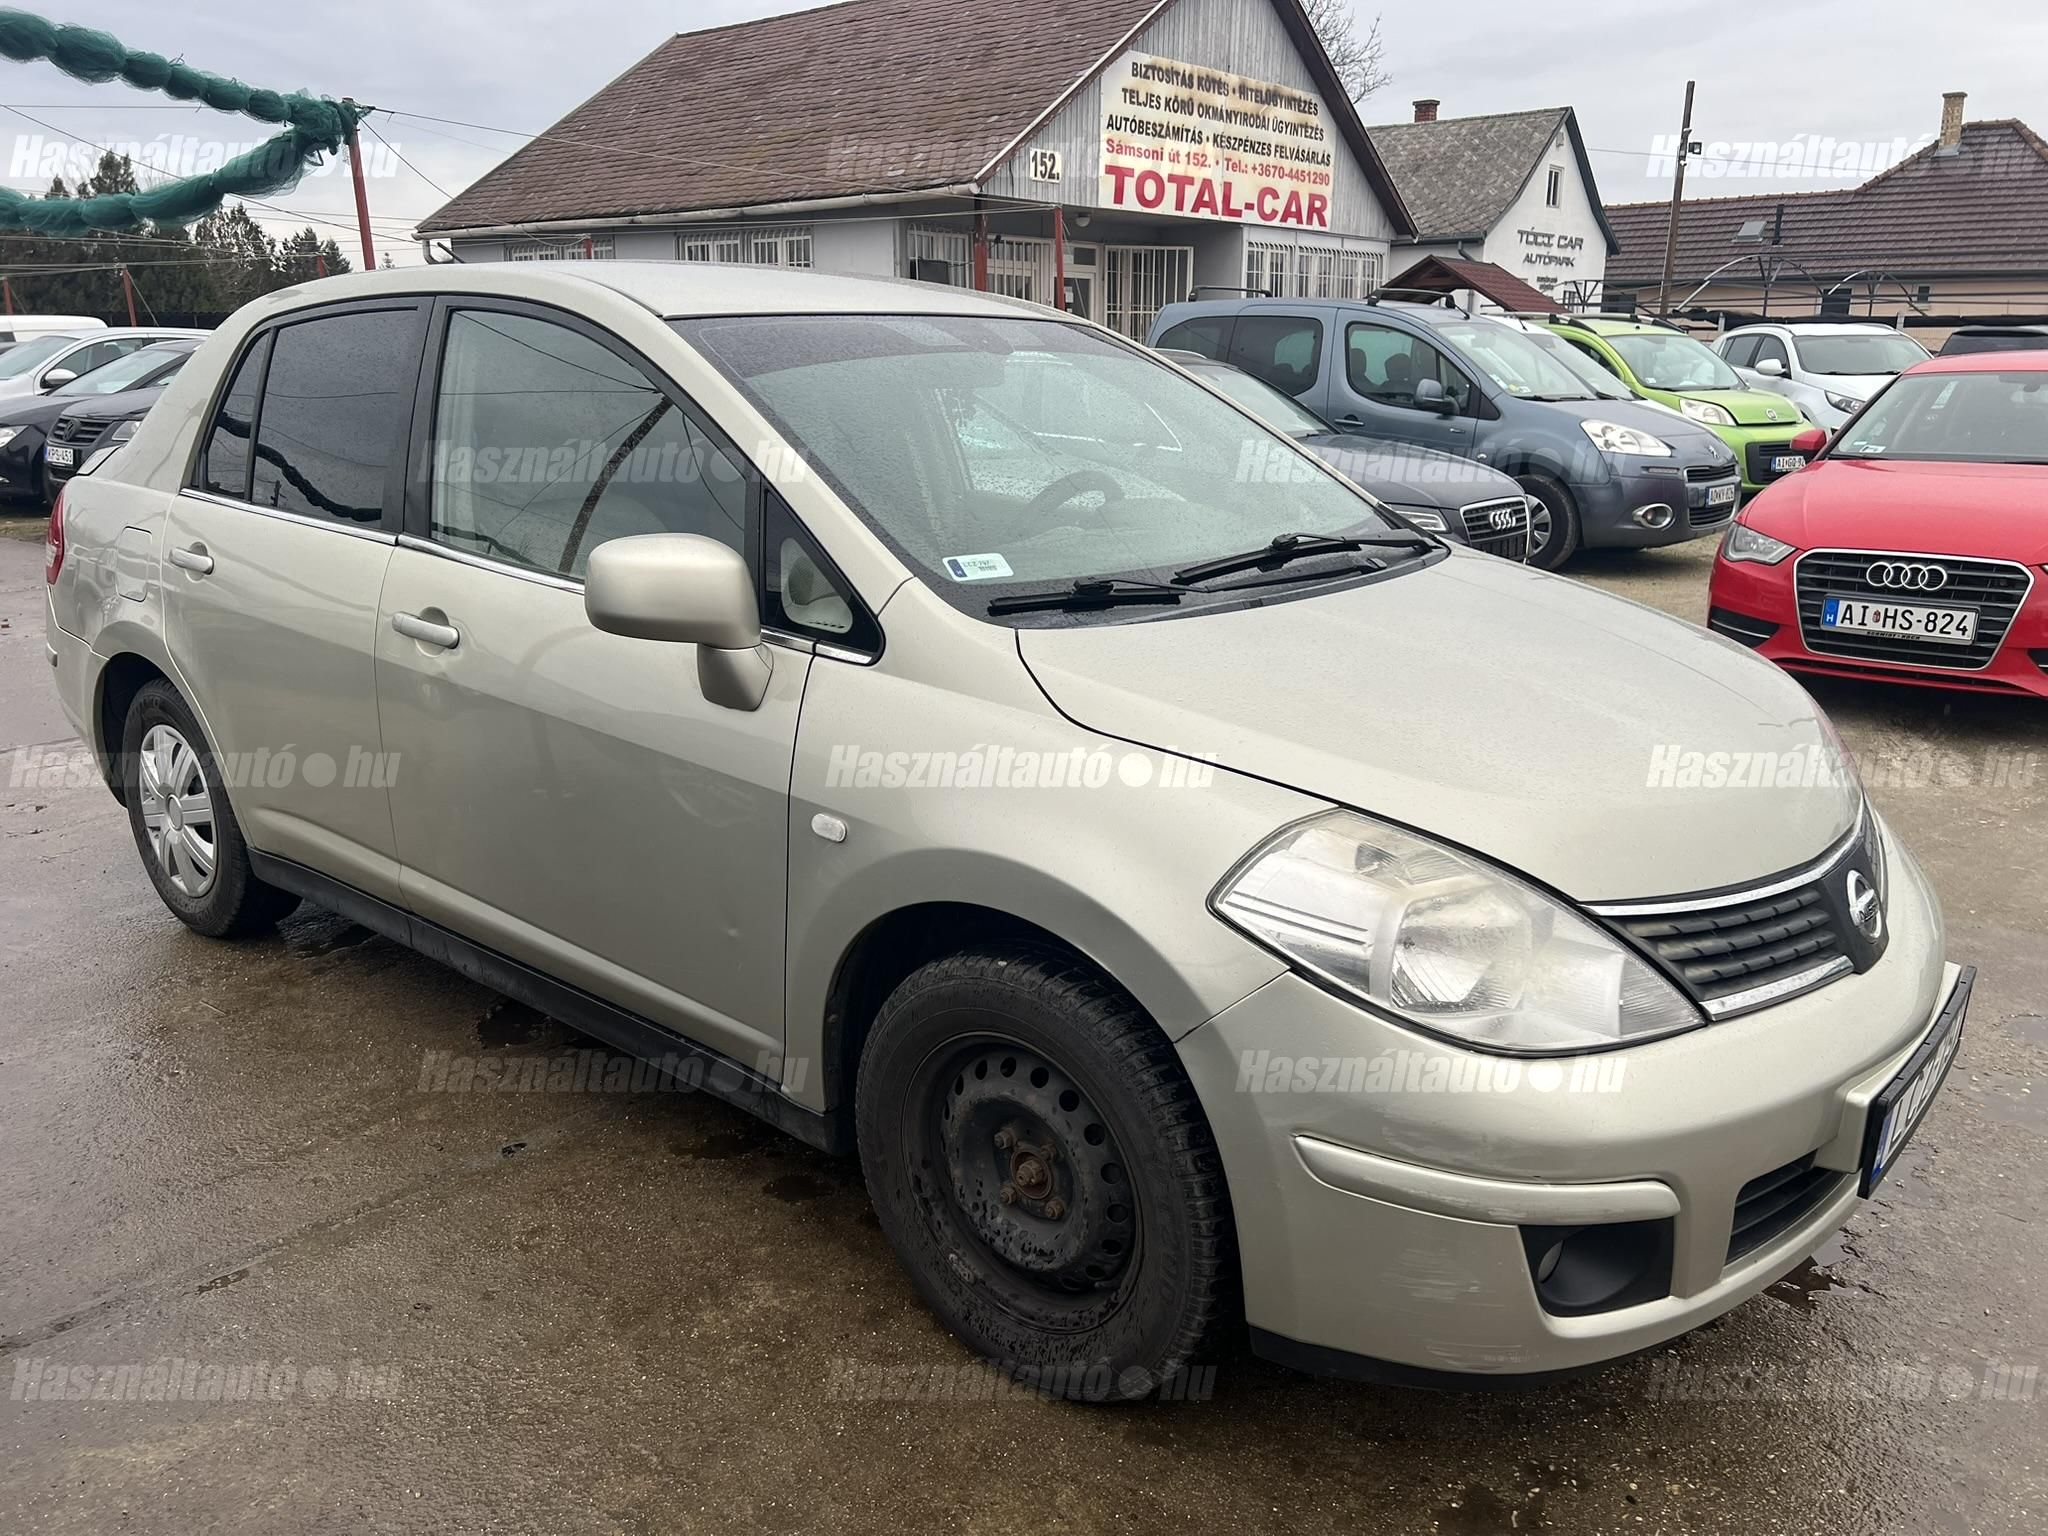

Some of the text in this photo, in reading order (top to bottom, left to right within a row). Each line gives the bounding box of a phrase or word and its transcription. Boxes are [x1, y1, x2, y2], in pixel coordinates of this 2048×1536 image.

[1131, 61, 1194, 89] BIZTOSÍTÁS
[1197, 74, 1229, 97] KÖTÉS
[1121, 87, 1161, 110] TELJES
[1197, 103, 1270, 131] OKMÁNYIRODAI
[1271, 115, 1324, 141] ÜGYINTÉZÉS
[1106, 114, 1331, 167] AUTÓBESZÁMÍTÁS KÉSZPÉNZES FELVÁSÁRLÁS
[1032, 151, 1060, 180] 152.
[1106, 138, 1330, 186] Sámsoni út 152. Tel.: +3670-4451290
[1105, 164, 1328, 227] TOTAL-CAR
[1557, 235, 1584, 250] CAR
[1523, 251, 1576, 267] AUTÓPARK
[1826, 613, 1834, 623] H
[1881, 607, 1968, 636] HS-824
